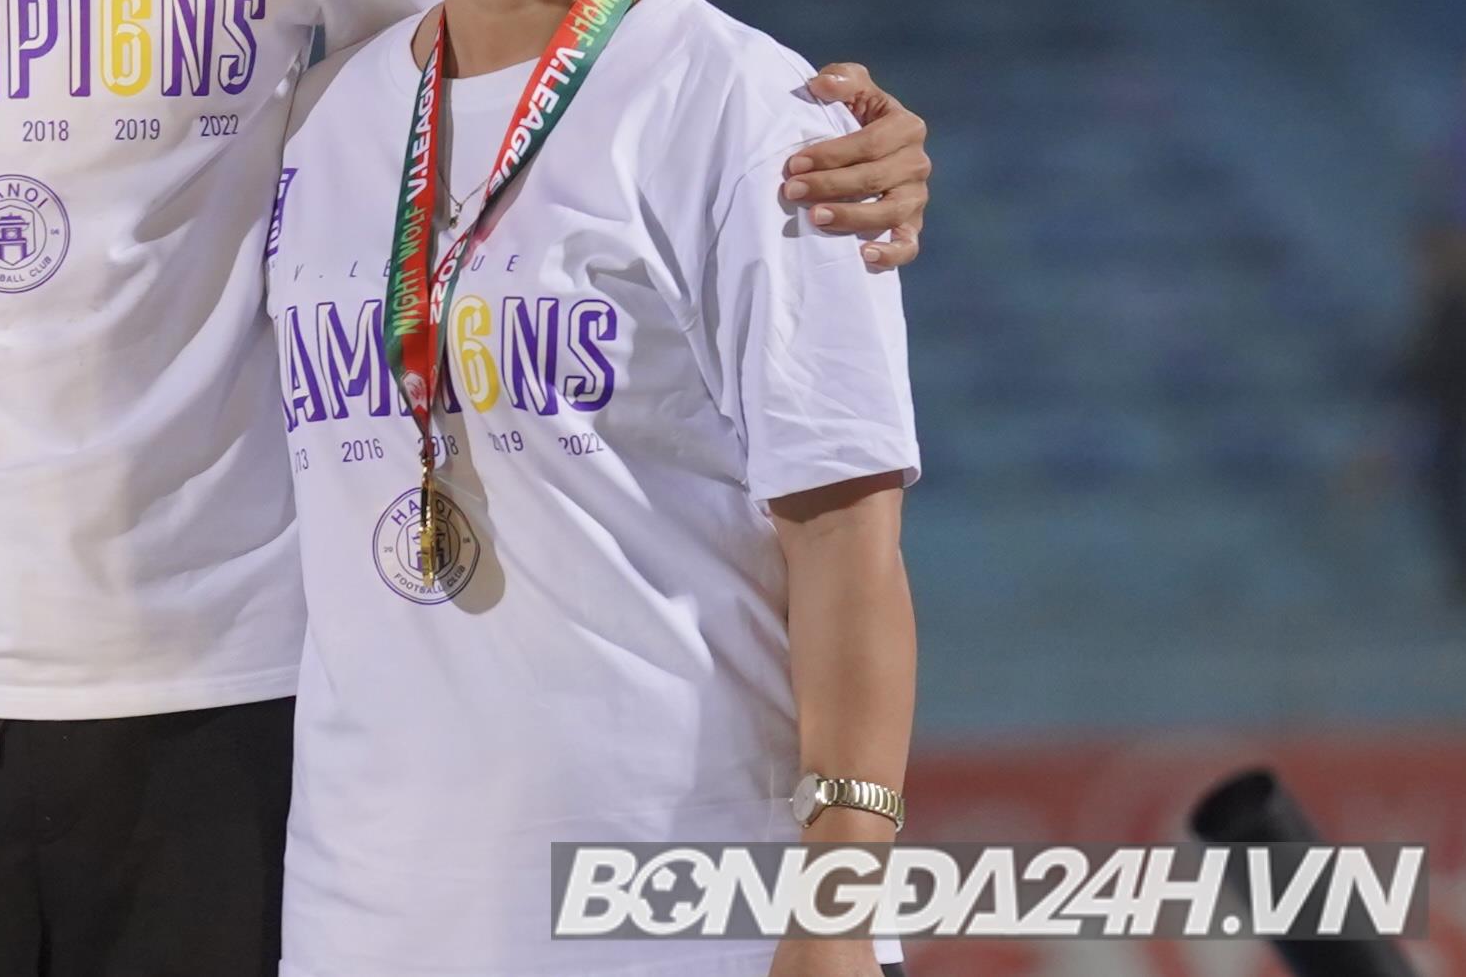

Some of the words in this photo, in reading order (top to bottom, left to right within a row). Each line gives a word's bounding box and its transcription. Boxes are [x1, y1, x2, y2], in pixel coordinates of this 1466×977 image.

[22, 120, 69, 142] 2018
[115, 119, 160, 141] 2019
[199, 114, 238, 137] 2022
[398, 206, 427, 264] WOLF
[29, 256, 52, 278] CLUB
[393, 268, 421, 337] NIGHT
[342, 438, 383, 463] 2016
[391, 499, 453, 525] HAOI
